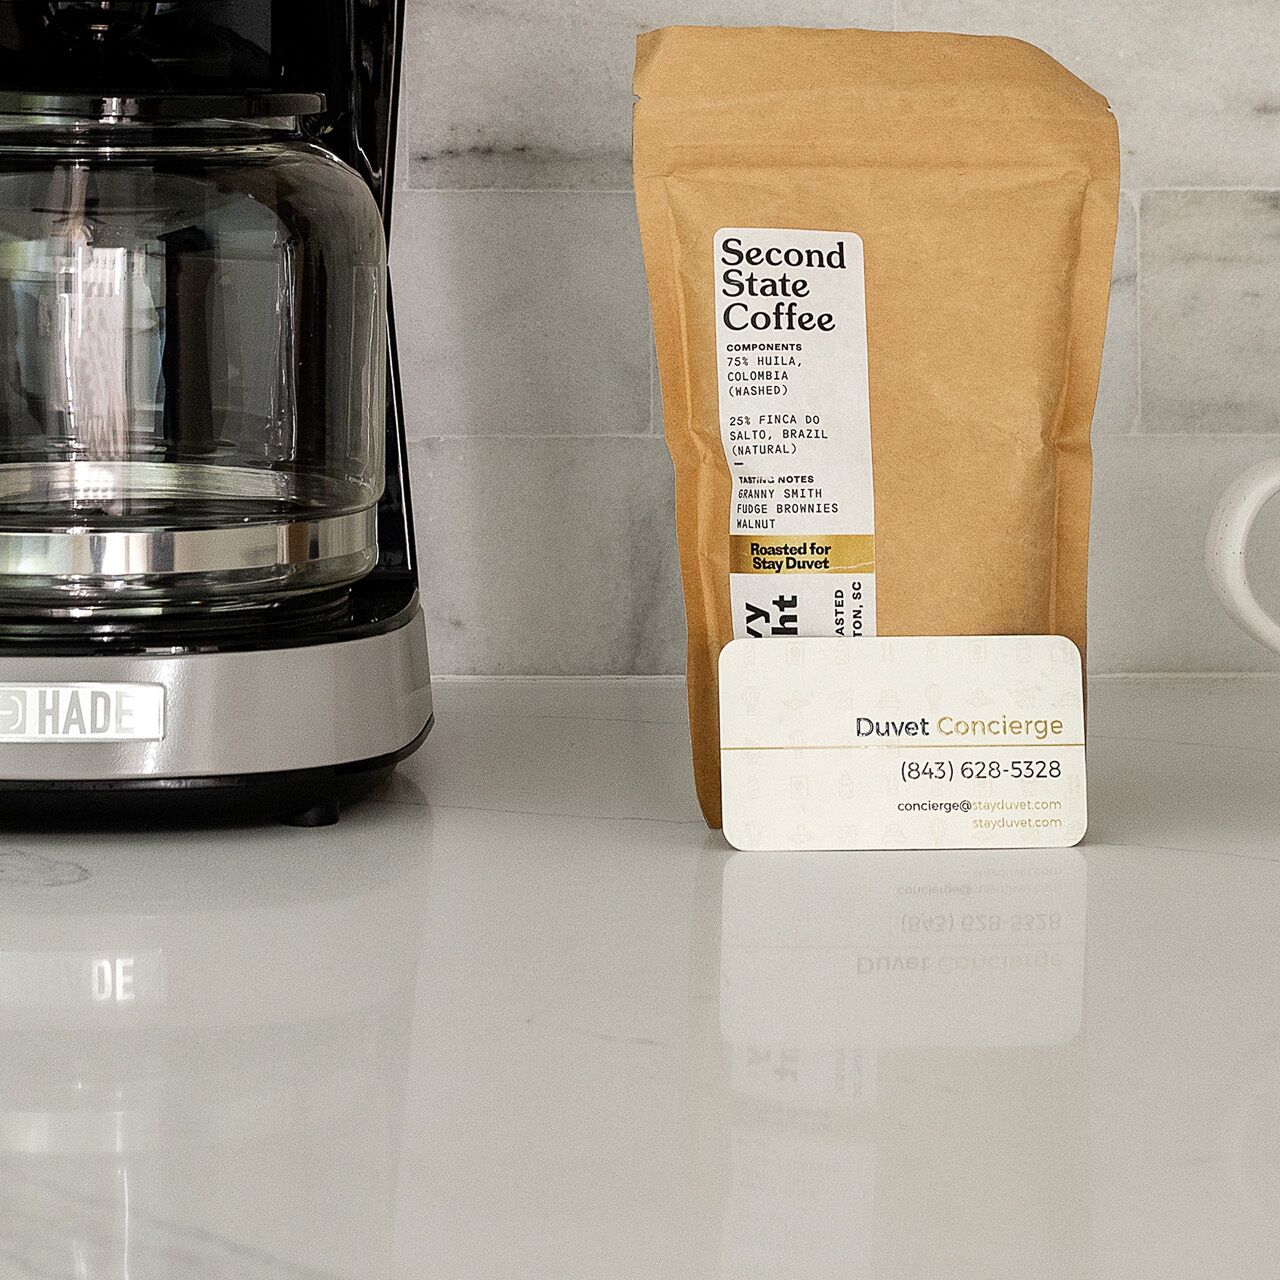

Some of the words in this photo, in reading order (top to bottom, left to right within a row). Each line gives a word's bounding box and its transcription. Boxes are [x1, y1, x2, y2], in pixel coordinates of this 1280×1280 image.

[721, 238, 847, 269] Second
[722, 269, 810, 298] State
[723, 302, 836, 332] Coffee
[726, 343, 803, 352] COMPONENTS
[727, 357, 749, 367] 75%
[757, 356, 802, 367] HUILA,
[727, 371, 789, 382] COLOMBIA
[729, 385, 788, 397] (WASHED)
[729, 417, 751, 426] 25%
[759, 415, 797, 425] FINCA
[805, 415, 820, 424] DO
[730, 430, 773, 441] SALTO,
[782, 429, 828, 439] BRAZIL
[732, 443, 797, 456] (NATURAL)
[738, 489, 775, 499] GRANNY
[783, 489, 822, 498] SMITH
[737, 504, 768, 514] FUDGE
[776, 503, 839, 513] BROWNIES
[736, 519, 775, 529] WALNUT
[751, 543, 807, 555] Roasted
[809, 542, 831, 555] for
[753, 557, 783, 573] Stay
[786, 557, 830, 569] Duvet
[852, 581, 862, 600] SC
[38, 689, 157, 734] HADE
[856, 718, 929, 737] Duvet
[937, 715, 1064, 739] Concierge
[901, 761, 954, 782] (843)
[960, 760, 1062, 779] 628-5328
